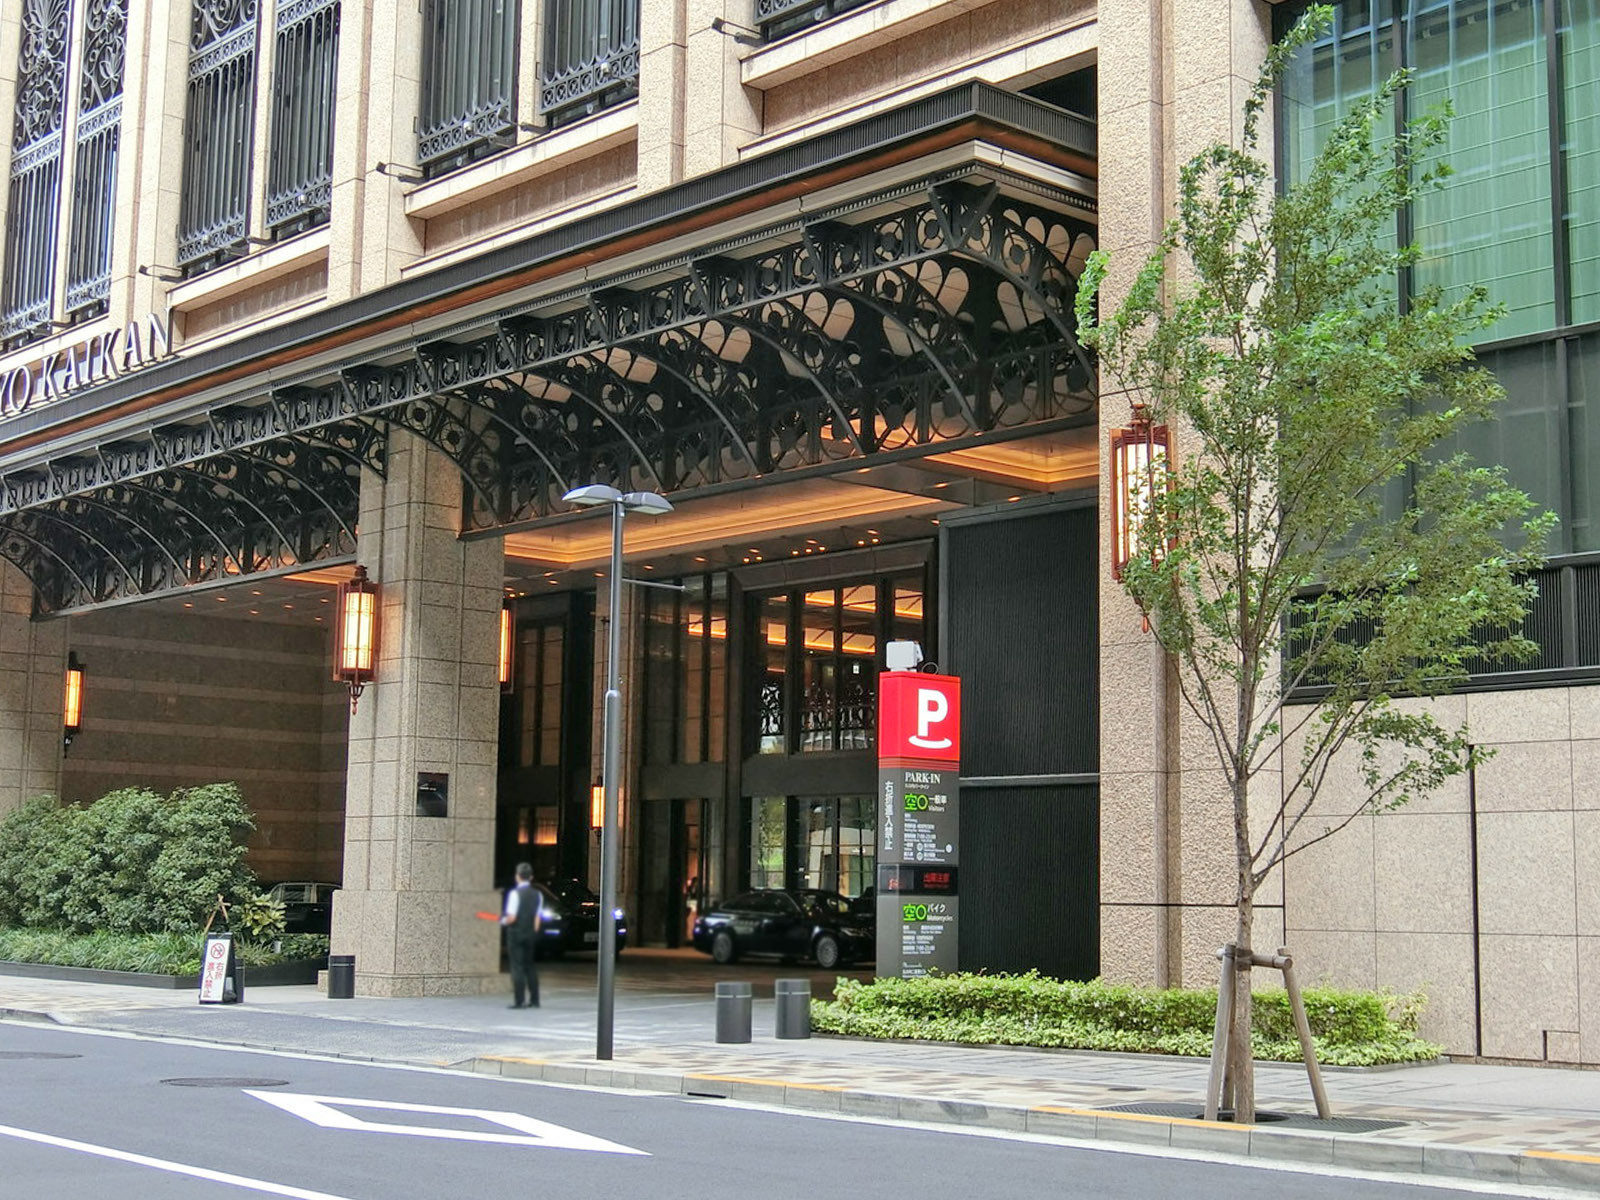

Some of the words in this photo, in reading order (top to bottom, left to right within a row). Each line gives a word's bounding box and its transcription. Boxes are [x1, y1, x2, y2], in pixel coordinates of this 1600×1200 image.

[41, 306, 174, 401] KAIKAN
[918, 688, 948, 737] P
[927, 903, 946, 913] バイク
